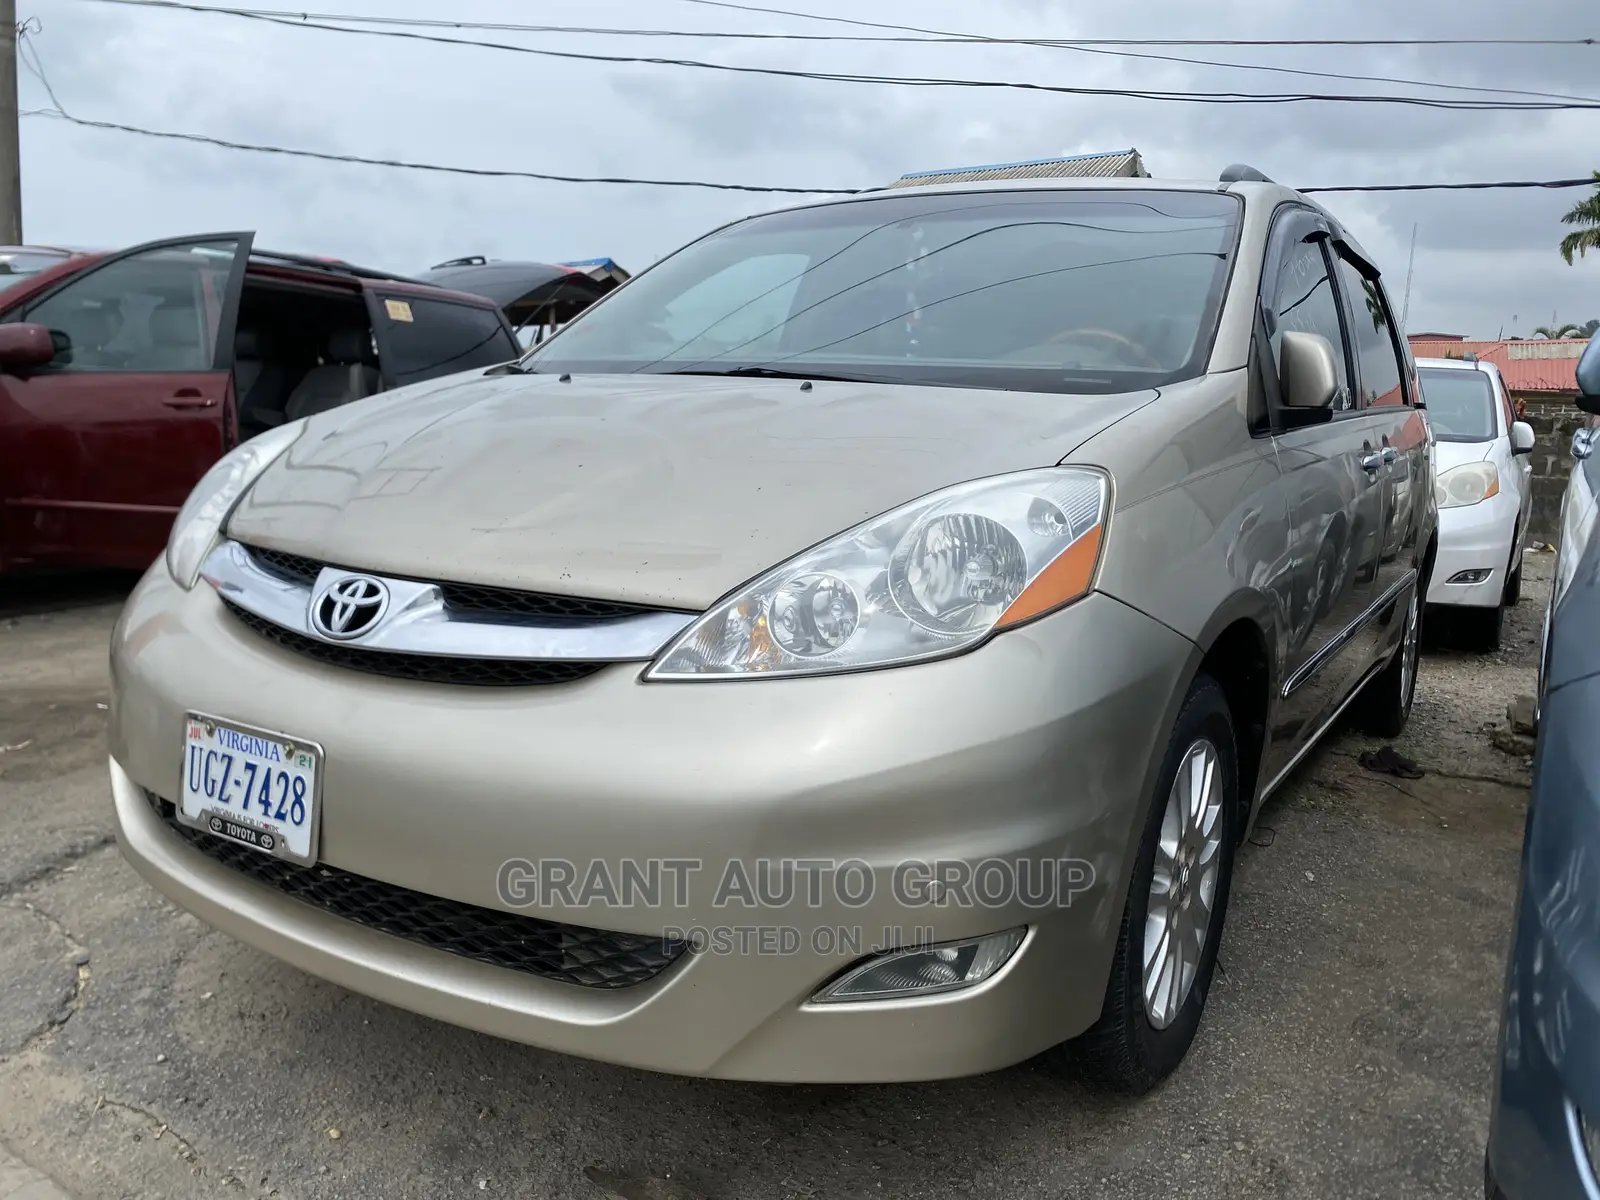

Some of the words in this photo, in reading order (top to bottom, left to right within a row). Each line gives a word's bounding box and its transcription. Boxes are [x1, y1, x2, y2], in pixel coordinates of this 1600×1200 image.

[188, 726, 201, 740] JUL
[217, 728, 281, 762] VIRGINIA
[299, 754, 312, 769] 21
[189, 744, 307, 827] UGZ-7428
[226, 822, 257, 844] TOYOTA
